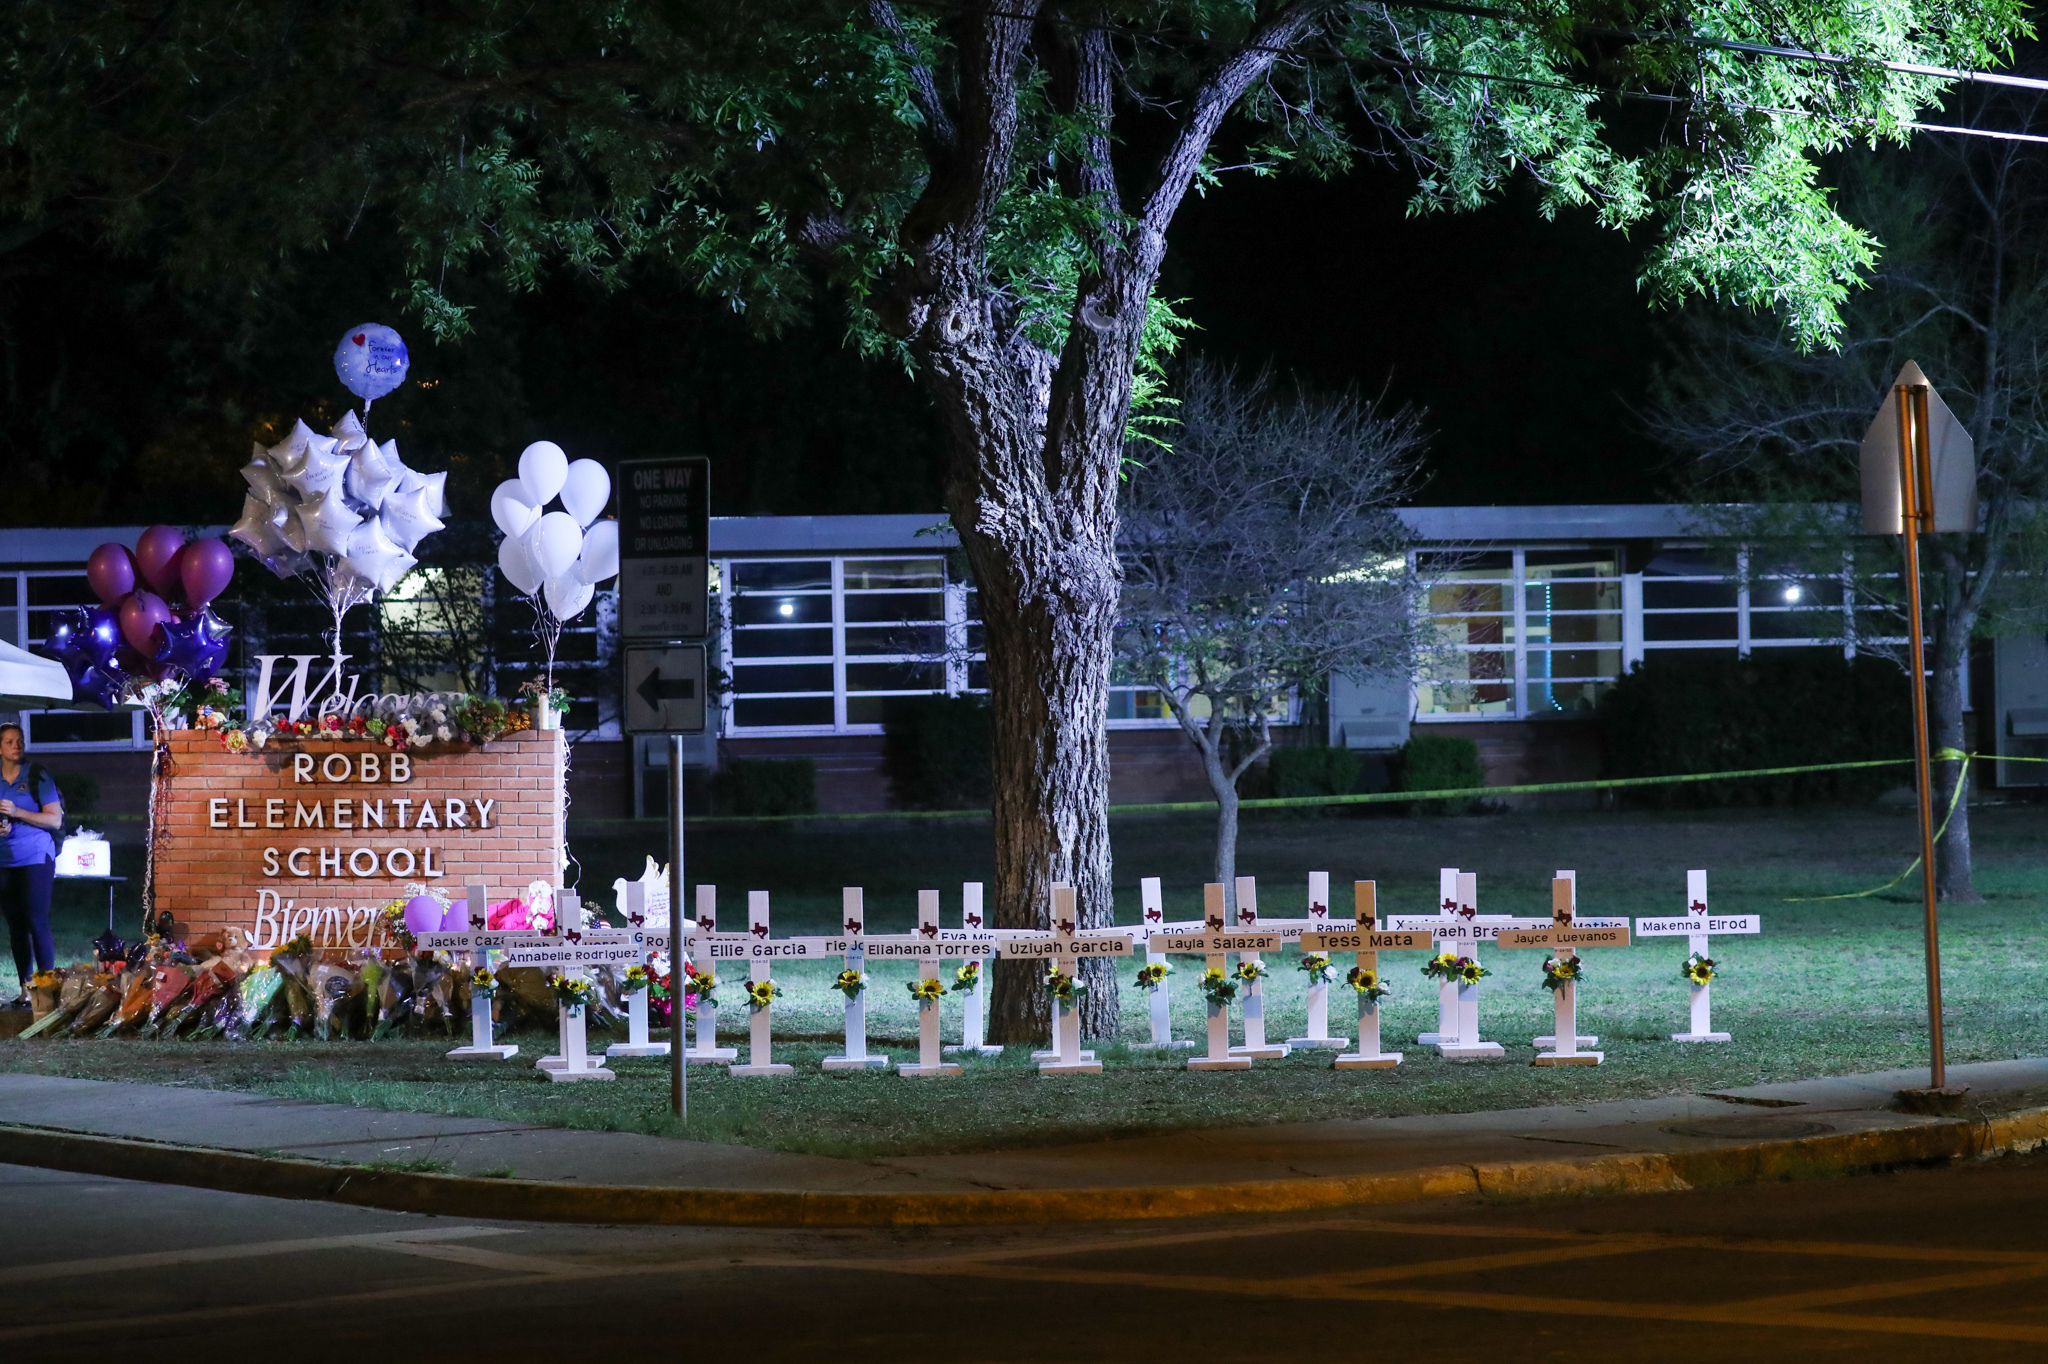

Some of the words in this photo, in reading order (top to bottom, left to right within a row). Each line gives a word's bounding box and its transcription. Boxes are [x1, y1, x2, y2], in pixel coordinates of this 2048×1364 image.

[365, 359, 397, 375] Hearts
[633, 469, 661, 490] ONE
[664, 467, 692, 488] WAY
[639, 495, 651, 509] NO
[653, 493, 687, 508] PARKING
[639, 516, 651, 530] NO
[653, 514, 688, 529] LOADING
[634, 537, 647, 551] OR
[648, 535, 693, 550] UNLOADING
[681, 563, 693, 576] AM
[656, 583, 672, 596] AND
[680, 602, 692, 614] PM
[294, 753, 412, 784] ROBB
[209, 798, 495, 829] ELEMENTARY
[262, 847, 444, 878] SCHOOL
[1643, 921, 1701, 932] Makenna
[1709, 918, 1747, 931] Elrod
[428, 936, 469, 948] Jackie
[1168, 938, 1204, 951] Layla
[1213, 937, 1273, 949] Salazar
[1318, 935, 1361, 948] Tess
[1369, 935, 1413, 947] Mata
[1514, 934, 1548, 945] Jayce
[1557, 932, 1617, 943] Luevanos
[710, 944, 744, 957] Ellie
[752, 943, 807, 956] Garcia
[868, 943, 931, 955] Eliahana
[936, 943, 991, 955] Torres
[1010, 941, 1063, 956] Uziyah
[1070, 940, 1123, 953] Garcia
[509, 952, 572, 963] Annabelle
[575, 949, 639, 962] Rodriguez
